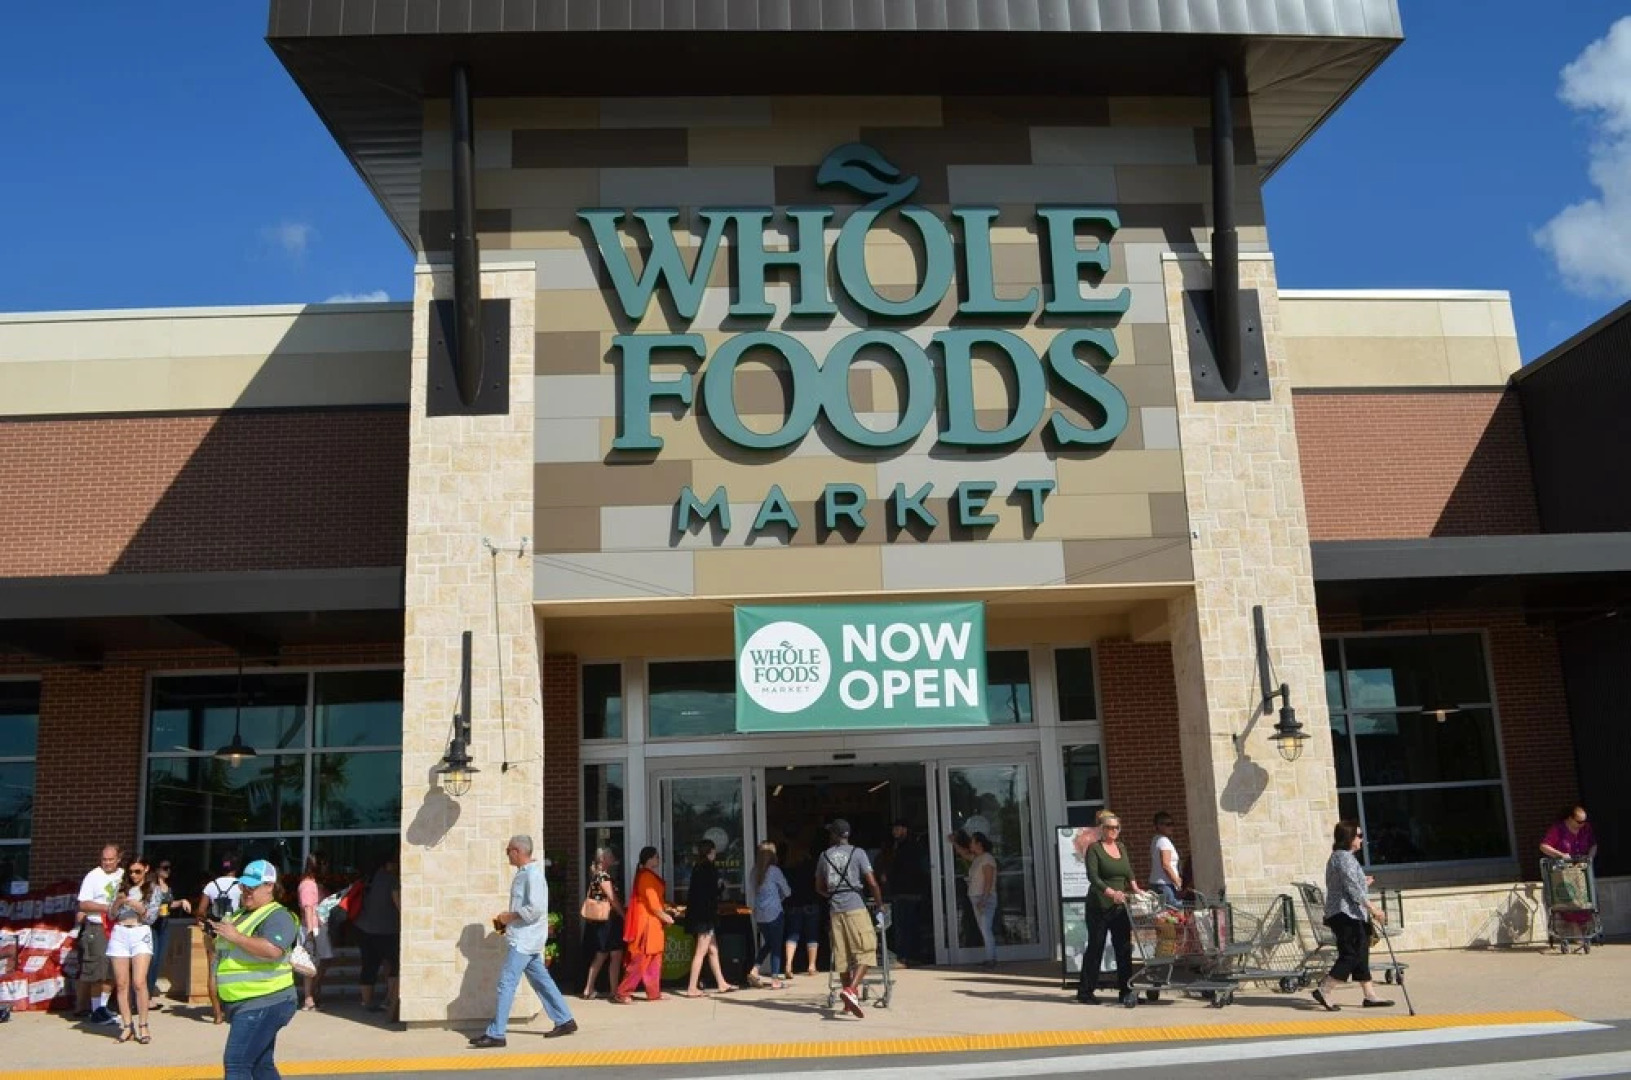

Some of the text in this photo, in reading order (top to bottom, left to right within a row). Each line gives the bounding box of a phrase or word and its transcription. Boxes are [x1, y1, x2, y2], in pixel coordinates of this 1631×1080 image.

[576, 207, 1131, 319] WHOLE
[611, 327, 1129, 450] FOODS
[676, 479, 1056, 533] MARKET
[749, 648, 821, 666] WHOLE
[842, 622, 973, 663] NOW
[754, 666, 820, 683] FOODS
[839, 668, 980, 711] OPEN
